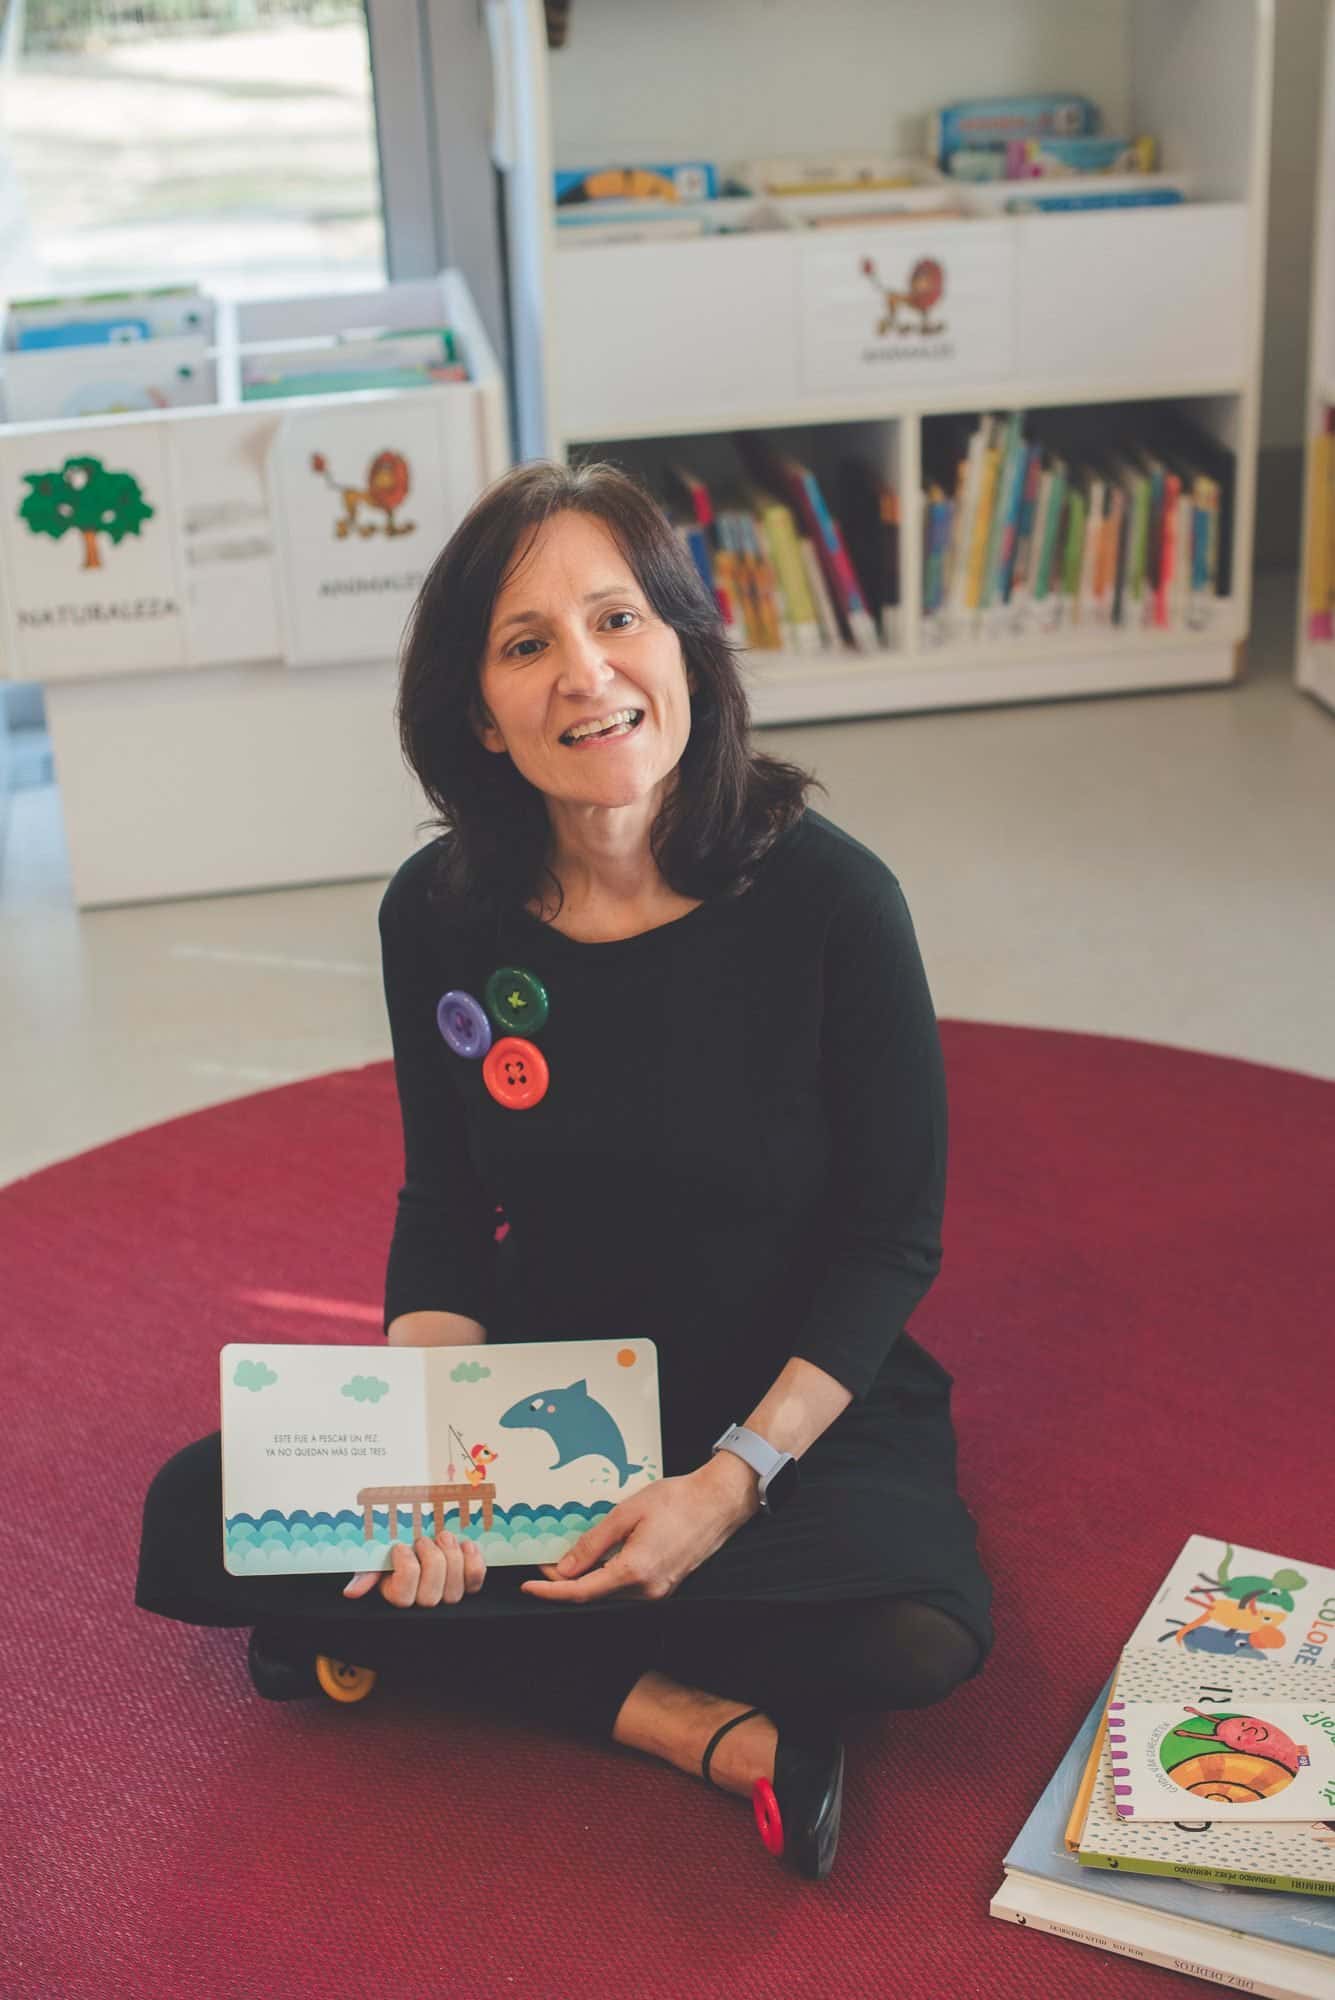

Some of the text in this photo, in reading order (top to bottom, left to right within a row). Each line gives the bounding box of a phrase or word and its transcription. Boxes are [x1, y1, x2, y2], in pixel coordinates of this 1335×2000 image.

[16, 597, 178, 627] NATURALEZA
[273, 1434, 292, 1443] ESTE
[294, 1434, 308, 1443] FUE
[319, 1434, 347, 1443] PESCAR
[351, 1434, 362, 1443] UN
[265, 1447, 276, 1456] YA
[278, 1447, 292, 1456] NO
[294, 1447, 329, 1456] QUEDAN
[351, 1447, 367, 1456] QUE
[1174, 1866, 1212, 1877] HERNANDO
[1239, 1873, 1276, 1885] FERNANDO
[1174, 1960, 1223, 1981] DEDITOS
[1227, 1975, 1254, 1990] DIEZ
